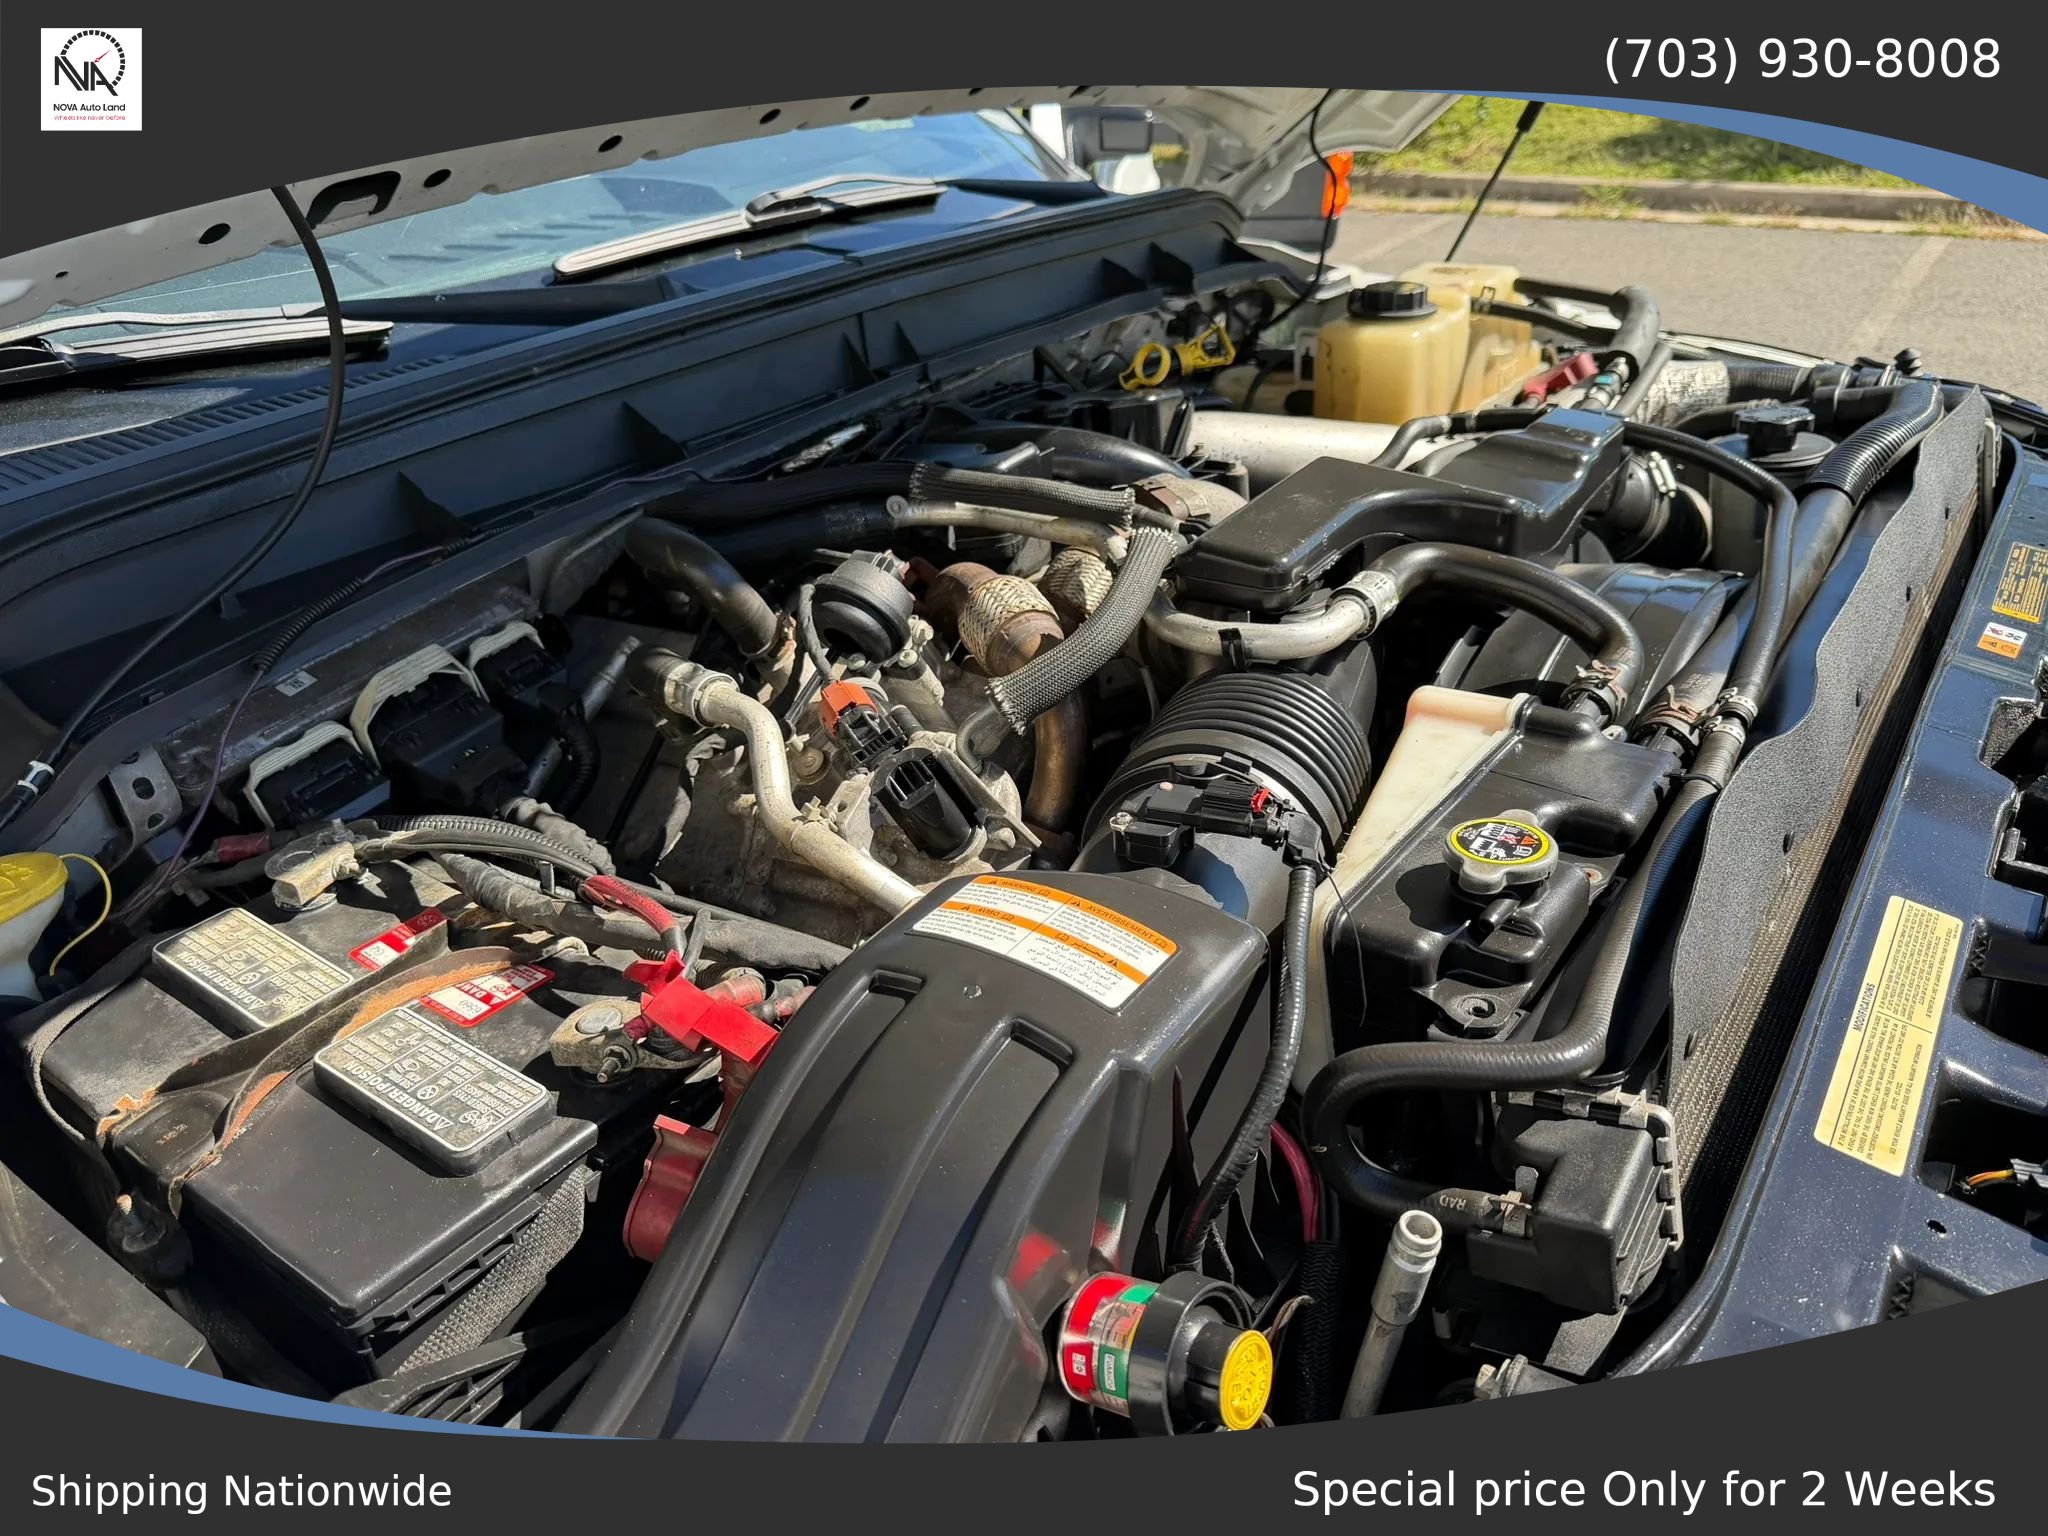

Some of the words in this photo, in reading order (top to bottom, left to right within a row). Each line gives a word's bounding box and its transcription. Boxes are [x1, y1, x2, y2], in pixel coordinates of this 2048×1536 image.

[1086, 905, 1154, 940] AVERTISSEMENT
[175, 950, 258, 1004] DANGER/POISON
[1853, 982, 1876, 1032] MODIFICATIONS
[341, 1059, 442, 1124] DANGER/POISON
